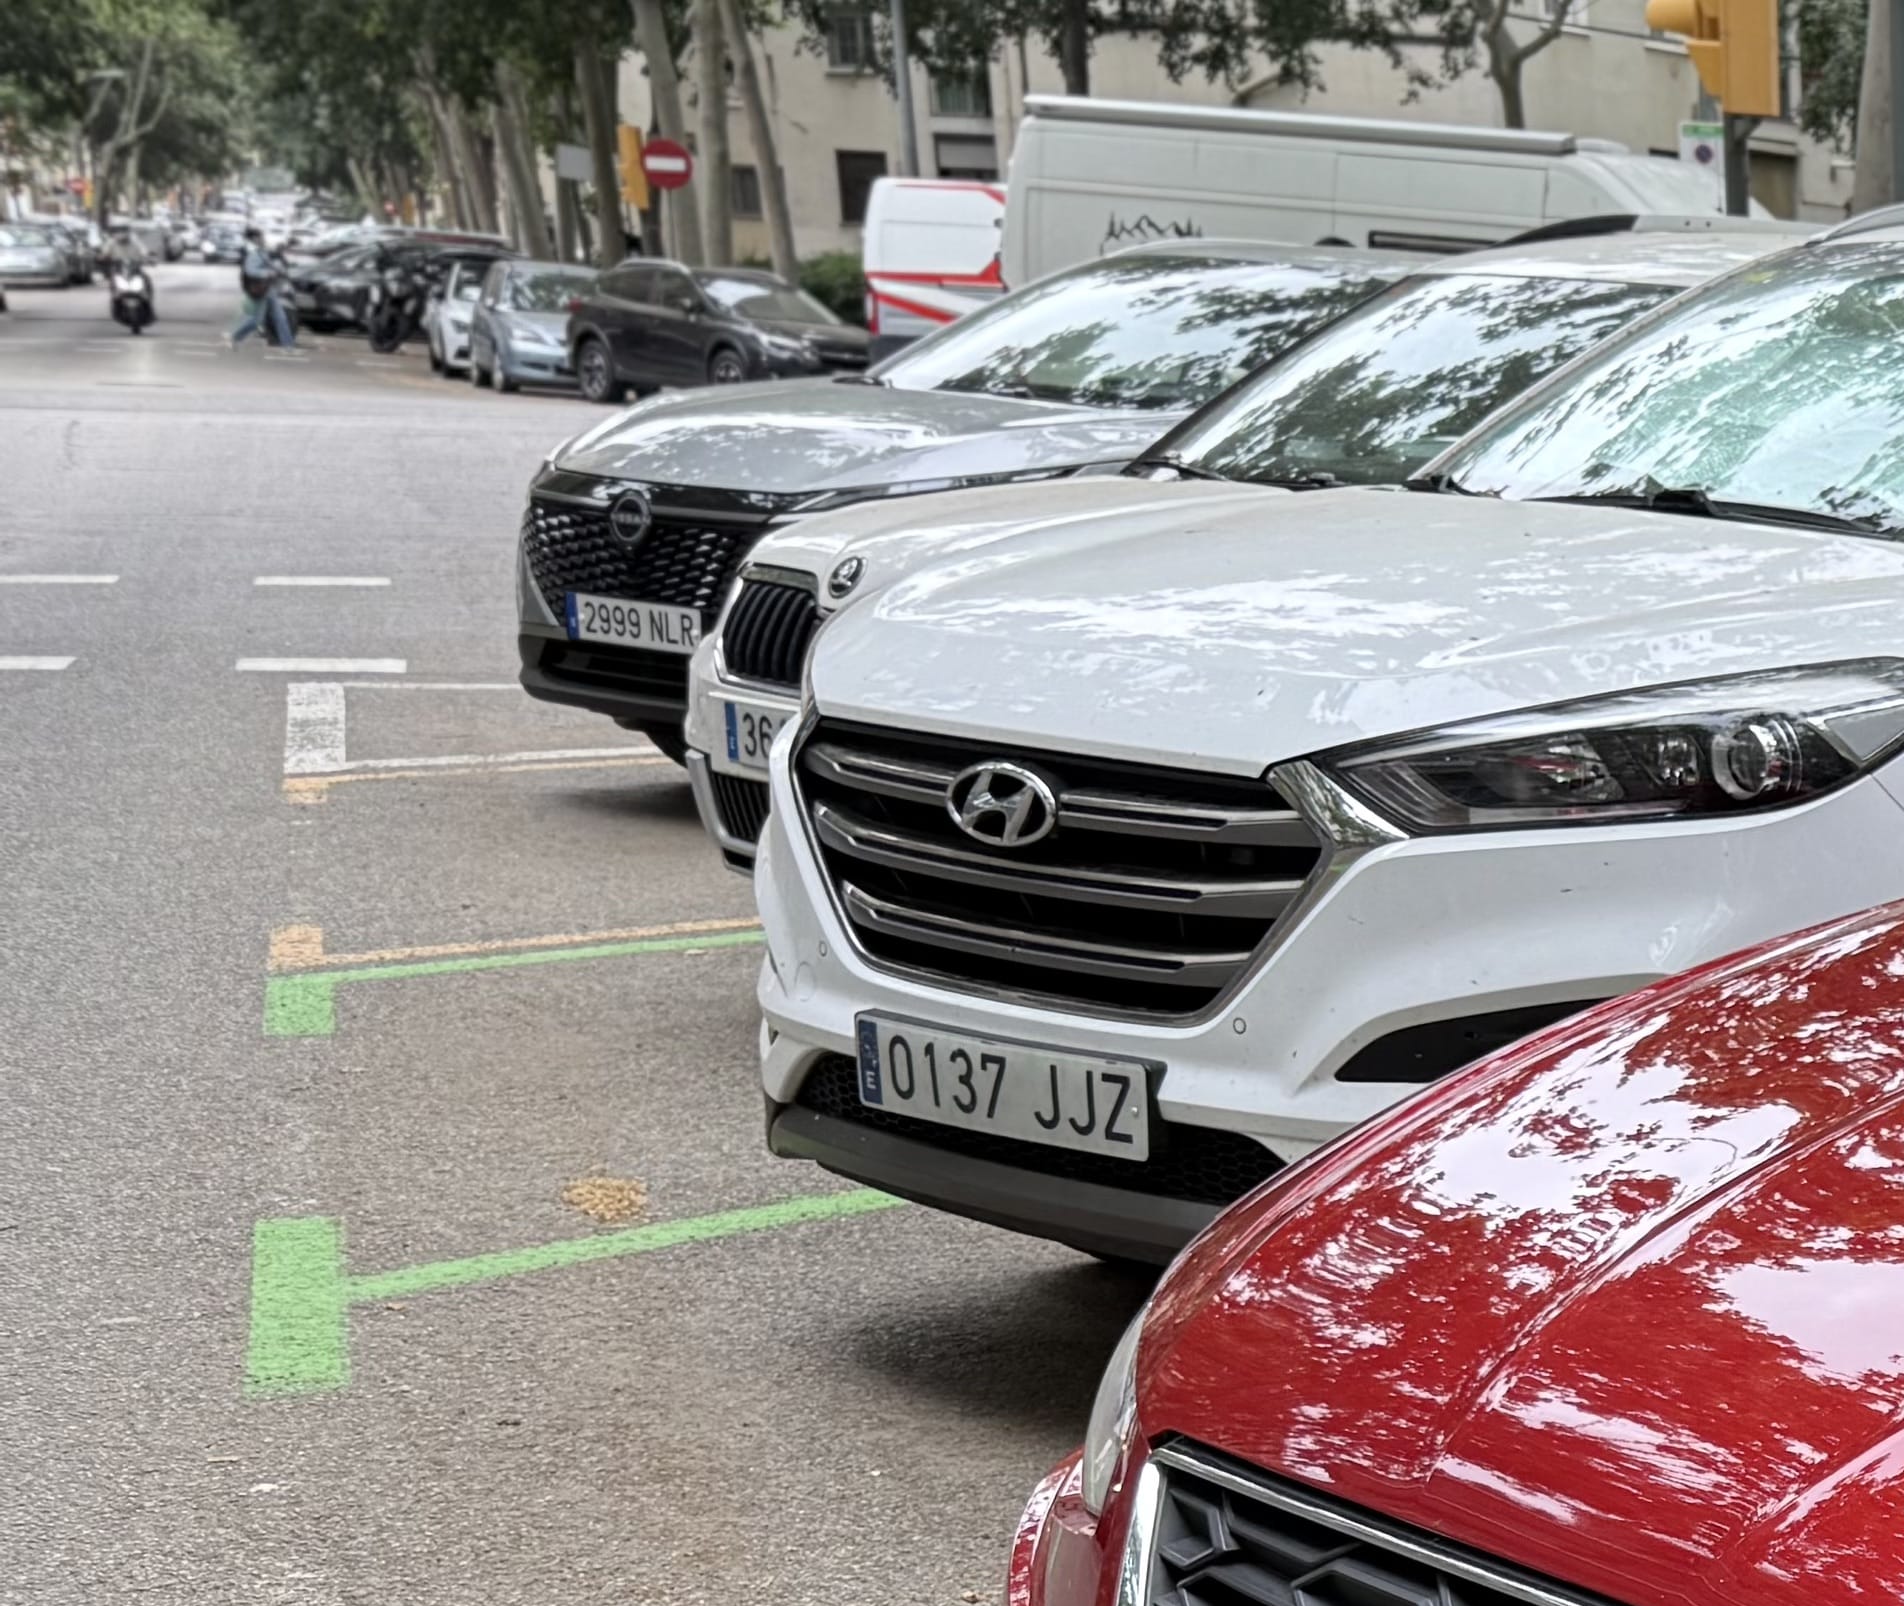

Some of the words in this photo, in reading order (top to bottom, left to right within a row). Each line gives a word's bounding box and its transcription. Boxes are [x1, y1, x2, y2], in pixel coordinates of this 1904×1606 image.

[584, 602, 641, 639] 2999
[650, 609, 694, 647] NLR
[743, 712, 788, 758] 36
[889, 1034, 1006, 1119] 0137
[1034, 1064, 1133, 1144] JJZ
